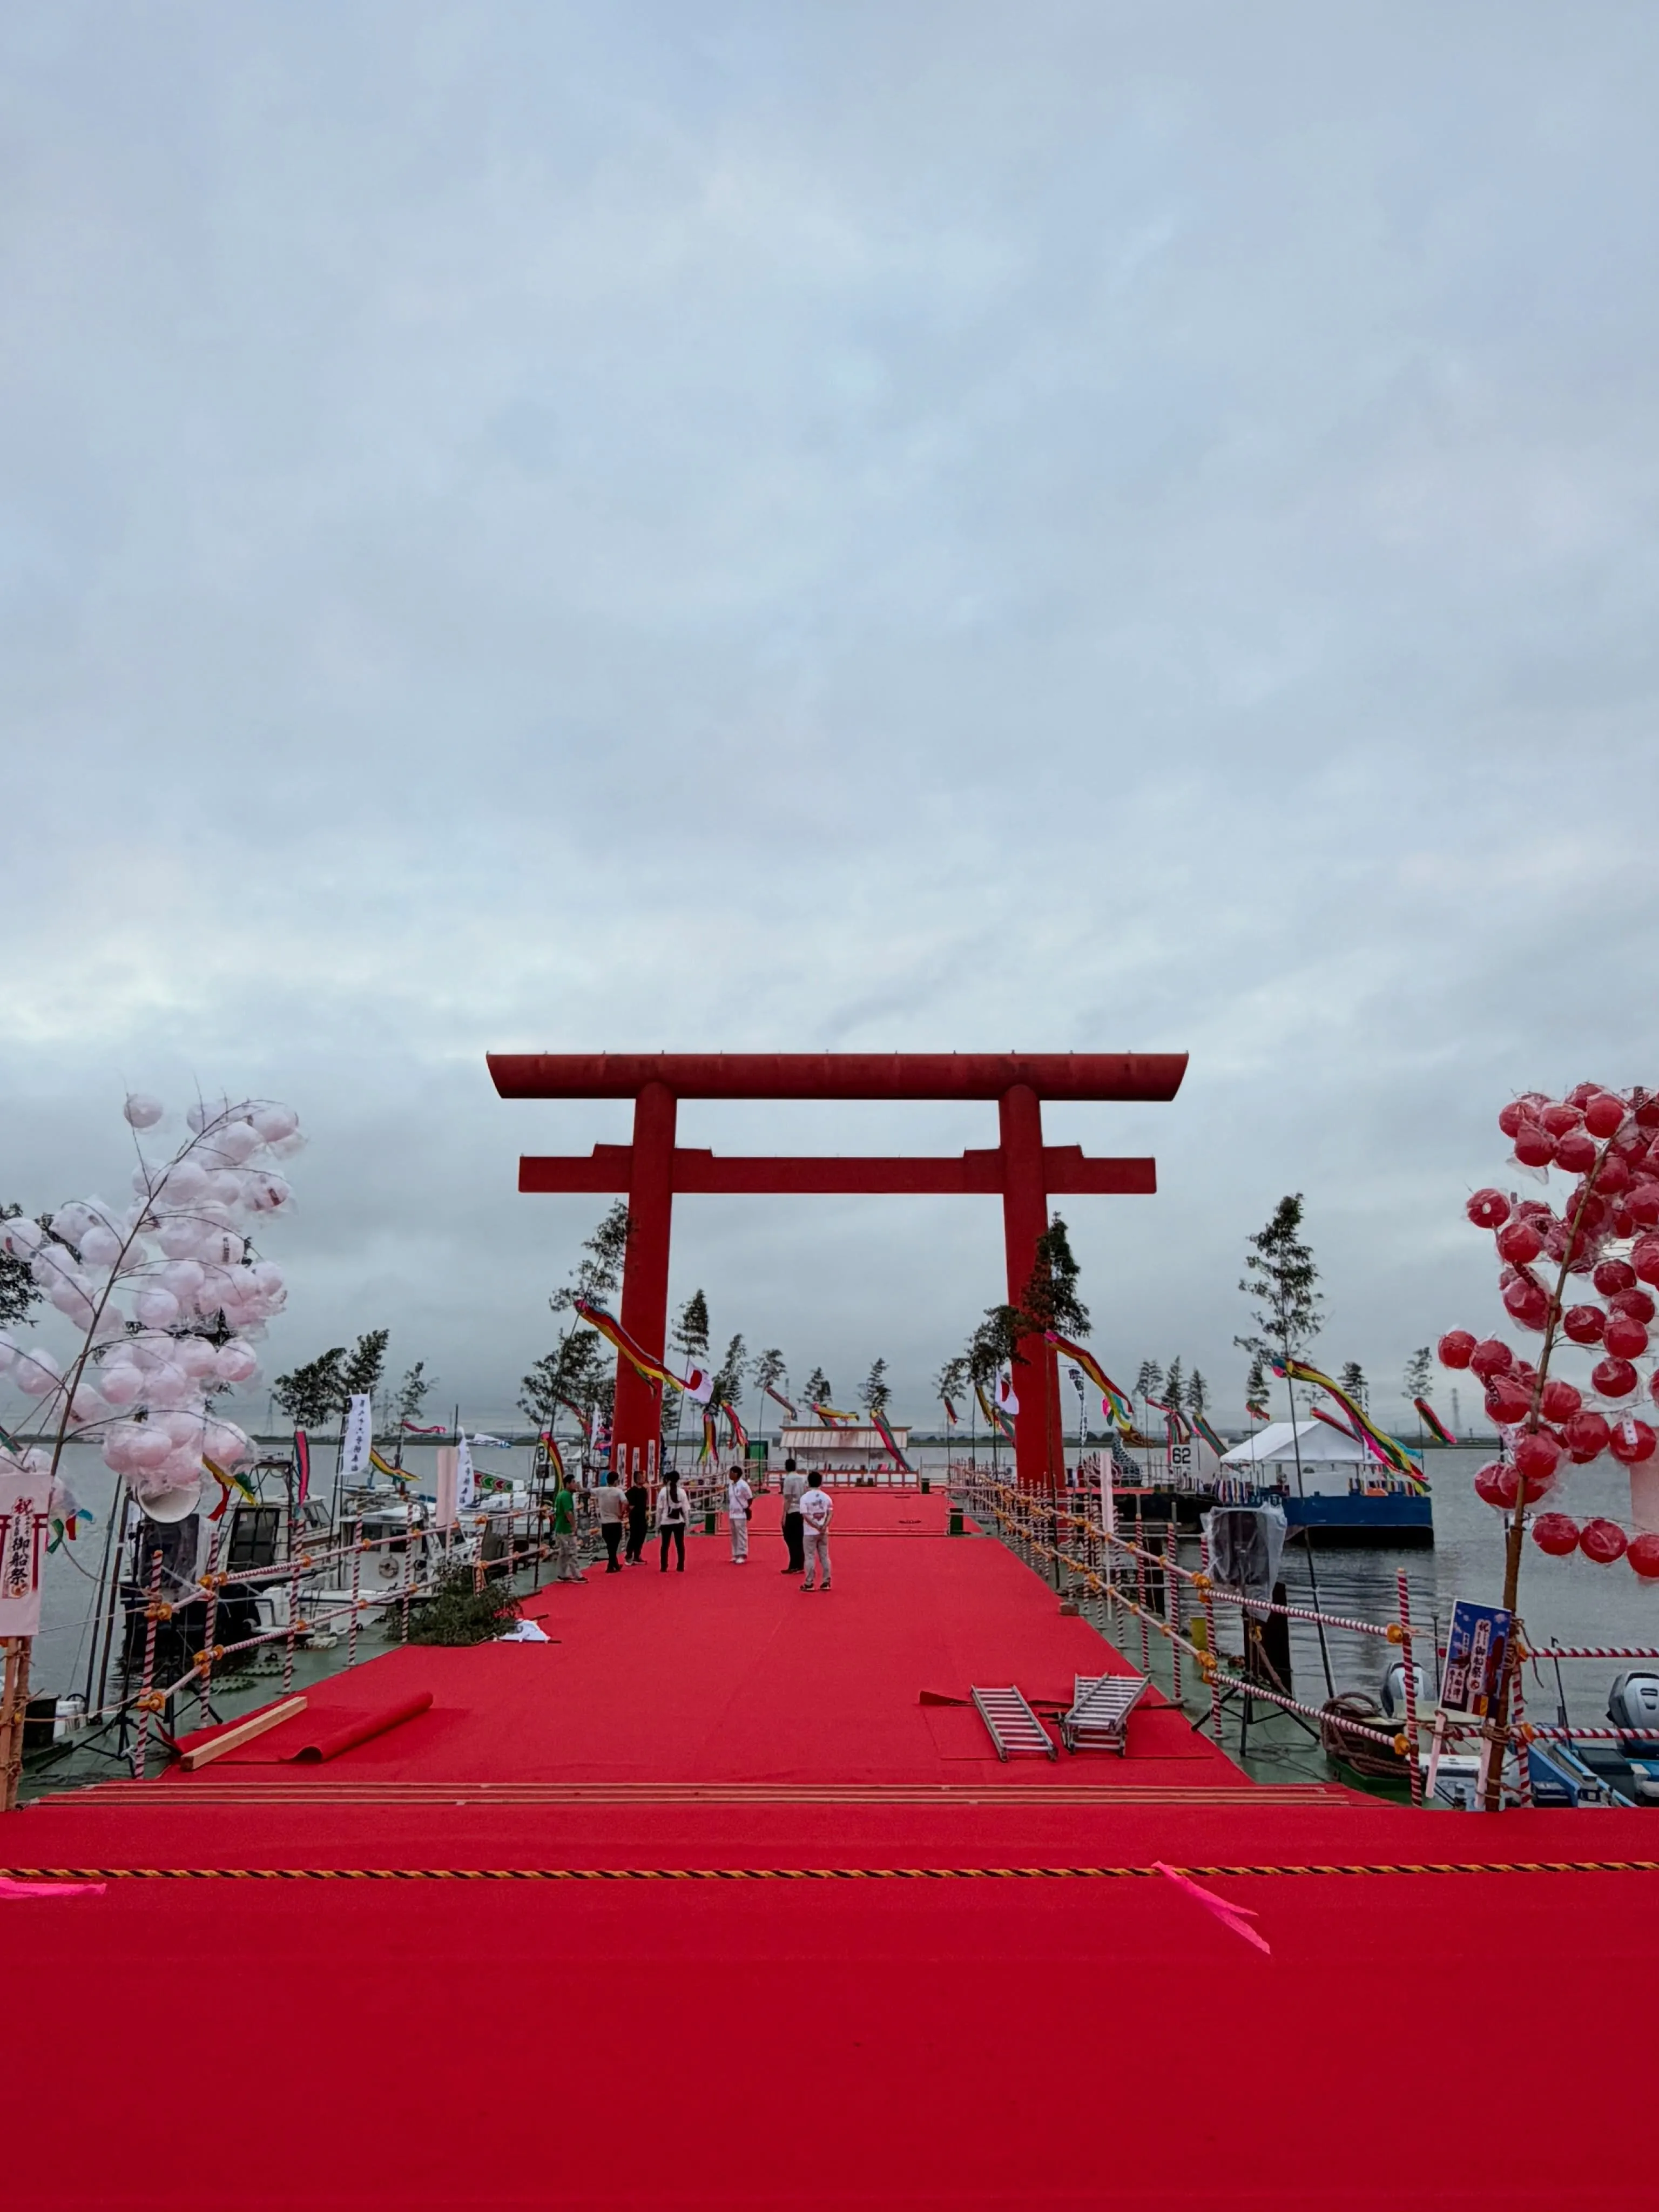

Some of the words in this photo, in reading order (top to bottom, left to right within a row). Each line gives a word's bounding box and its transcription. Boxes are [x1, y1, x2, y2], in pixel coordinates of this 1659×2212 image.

[1173, 1447, 1191, 1464] 62
[14, 1499, 33, 1515] 祝
[8, 1536, 30, 1586] 御船祭
